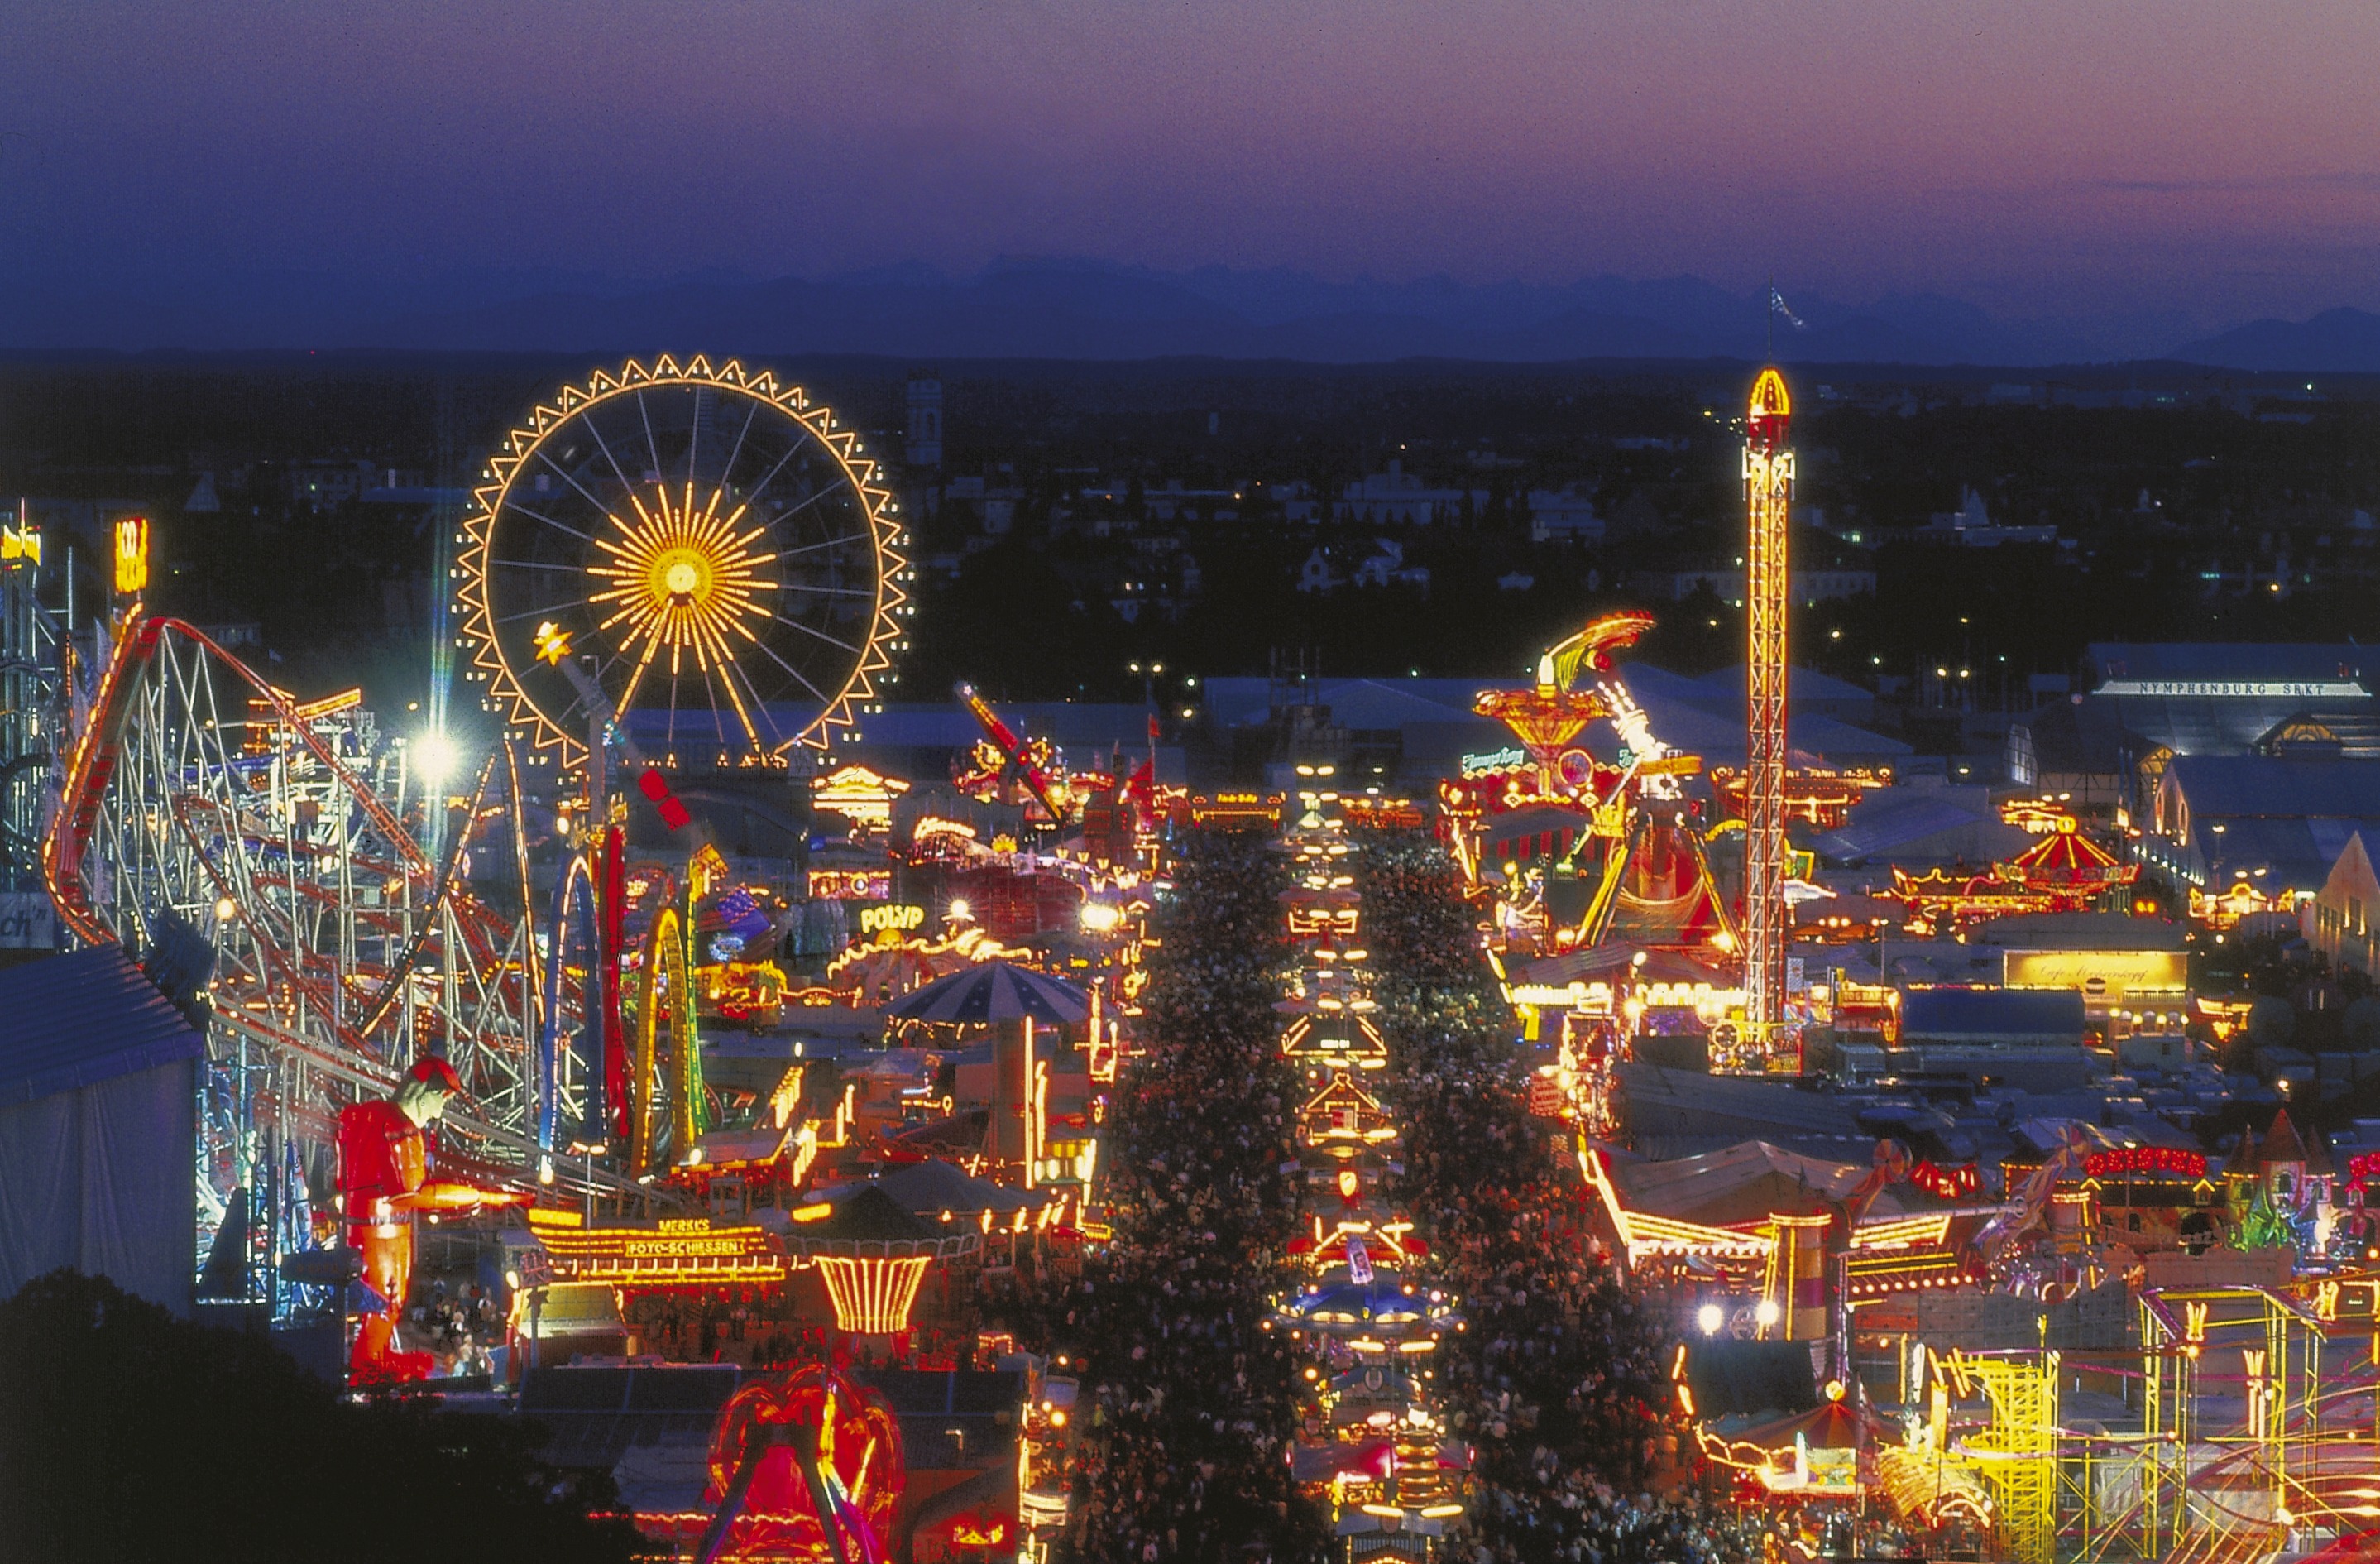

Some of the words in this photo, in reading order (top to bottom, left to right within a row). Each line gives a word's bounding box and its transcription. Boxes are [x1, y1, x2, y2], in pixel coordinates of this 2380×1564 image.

[2140, 684, 2267, 694] NYMPHENBURG
[861, 904, 924, 934] POLYP
[629, 1242, 738, 1254] FOTO-SCHIESSEN
